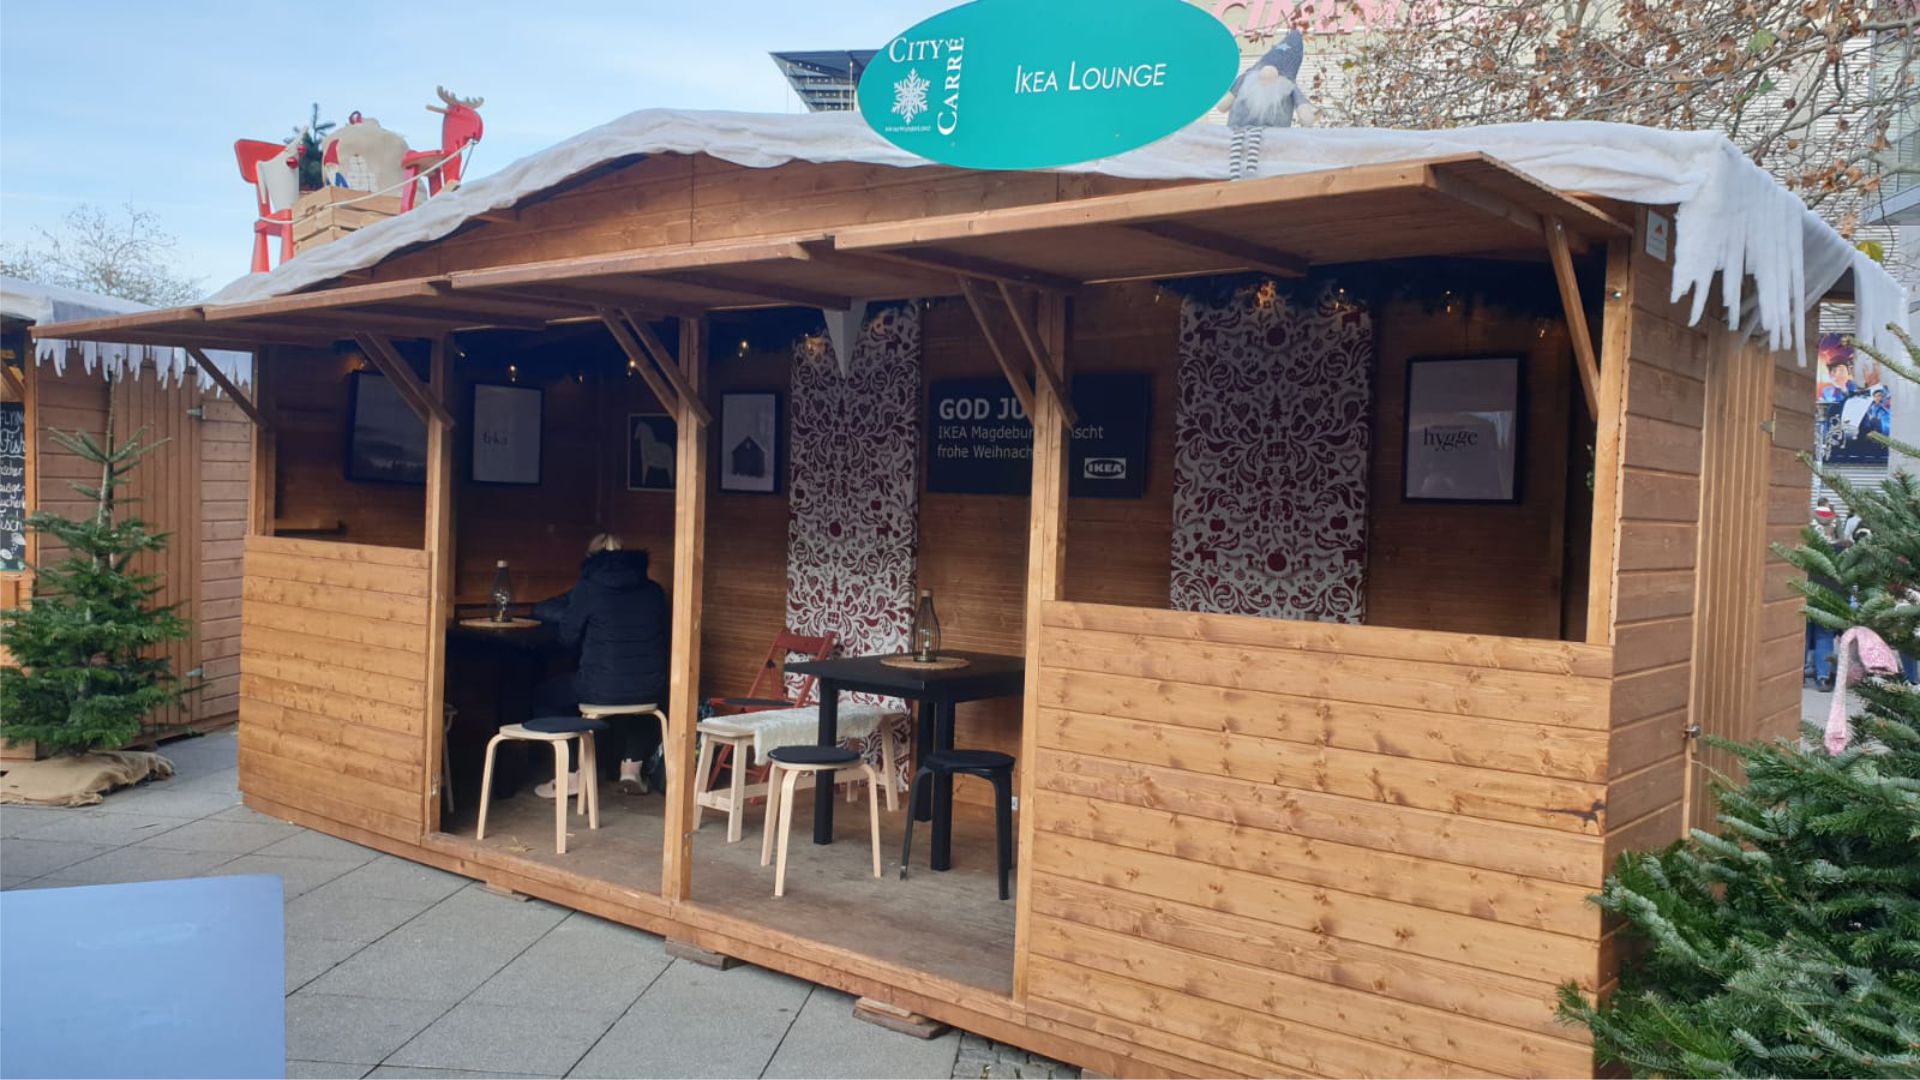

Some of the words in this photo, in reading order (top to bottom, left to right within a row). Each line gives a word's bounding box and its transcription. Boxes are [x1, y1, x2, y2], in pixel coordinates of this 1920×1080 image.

[888, 36, 943, 63] CITY
[937, 37, 964, 136] CARRÉ
[1014, 64, 1058, 94] IKEA
[1068, 60, 1167, 91] LOUNGE
[938, 397, 990, 420] GOD
[997, 397, 1029, 420] JU
[938, 426, 967, 439] IKEA
[971, 426, 1034, 442] Magdebur
[1071, 424, 1104, 440] scht
[1423, 427, 1478, 452] hygge
[937, 444, 969, 458] frohe
[973, 444, 1033, 459] Weihnach
[1088, 463, 1122, 473] IKEA
